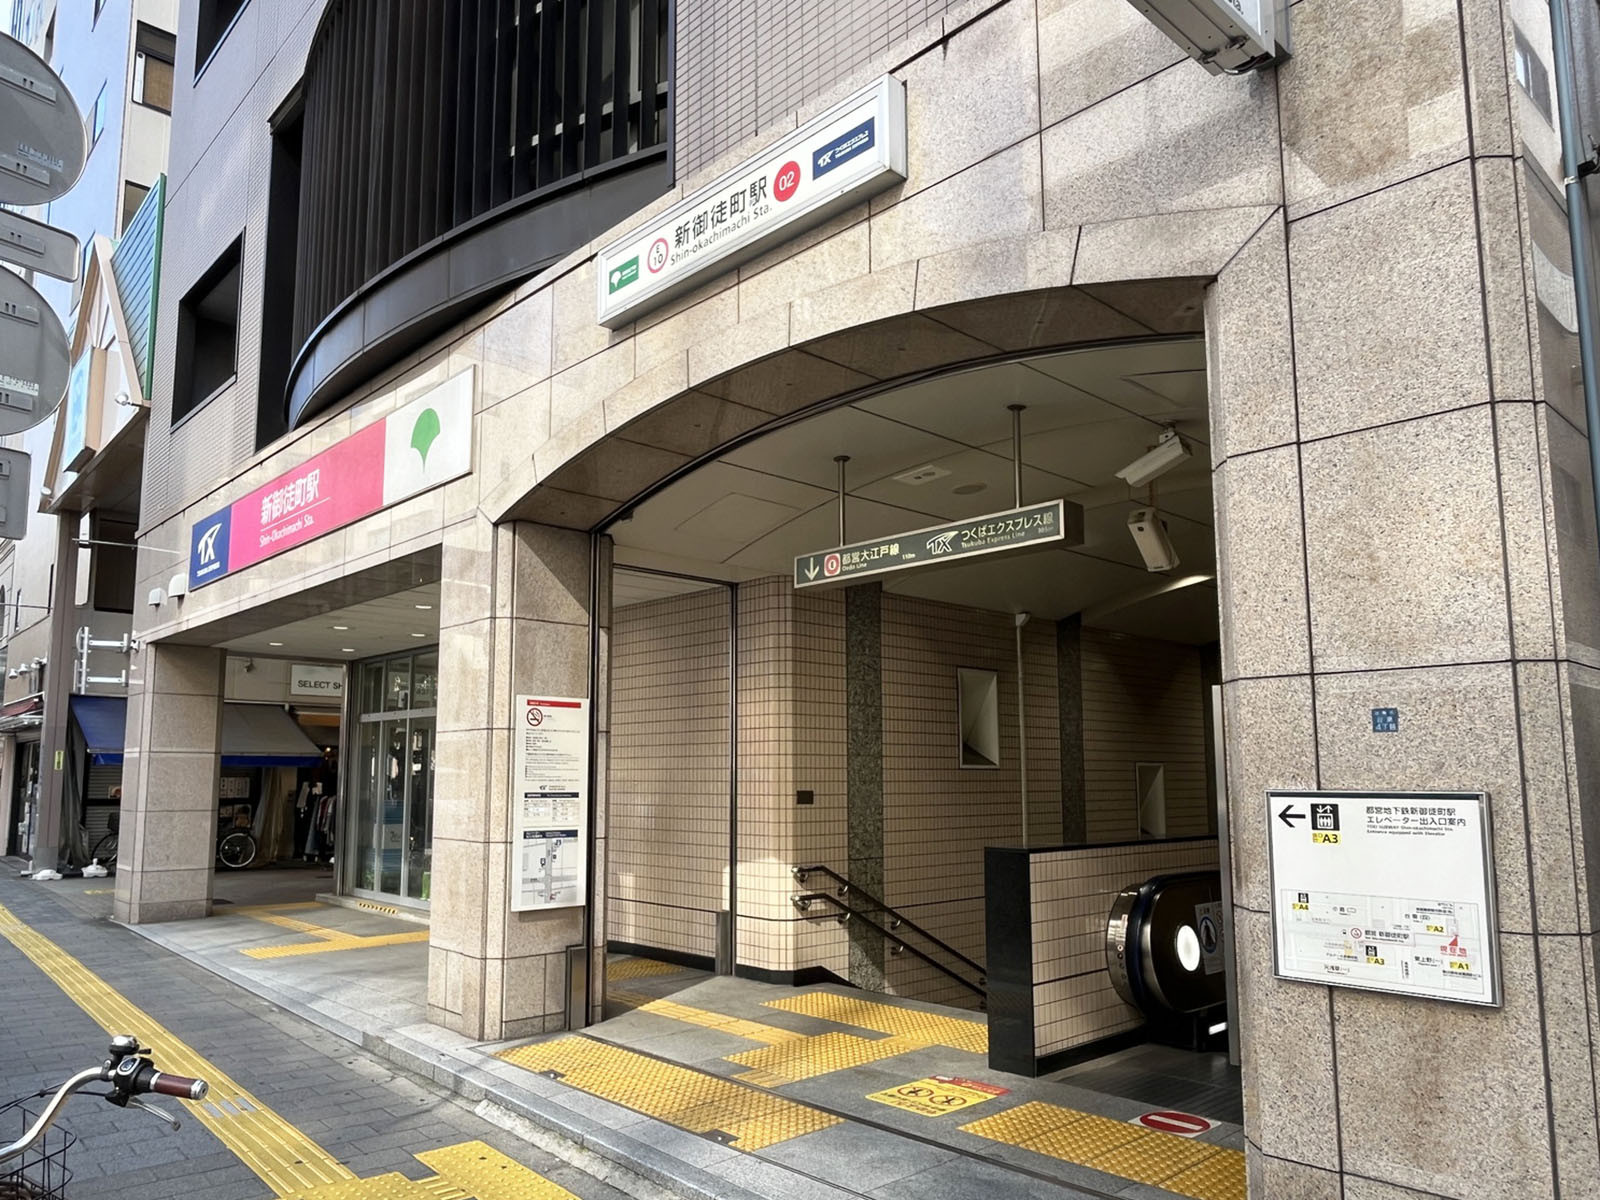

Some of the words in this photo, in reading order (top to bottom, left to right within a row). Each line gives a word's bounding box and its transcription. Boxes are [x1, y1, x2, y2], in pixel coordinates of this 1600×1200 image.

[779, 170, 795, 192] 02
[674, 175, 767, 249] 新御徒町駅
[670, 211, 751, 266] Shin-okachimachi
[753, 203, 773, 220] Sta.
[653, 253, 664, 266] 10
[260, 468, 320, 526] 新御徒町駅
[961, 511, 1054, 541] つくばエクスプレス線
[197, 522, 223, 566] TX
[926, 530, 959, 555] TX
[961, 539, 986, 549] Tsukuba
[986, 534, 1011, 545] Express
[841, 543, 900, 565] 都営大江戸線
[297, 680, 331, 690] SELECT
[1366, 806, 1456, 816] 都営地下鉄新御徒町駅
[1367, 816, 1466, 827] エレベーター出入口案内
[1322, 833, 1339, 844] A3
[1440, 945, 1468, 955] 現在地
[1374, 958, 1385, 966] A3
[1457, 962, 1469, 970] A1
